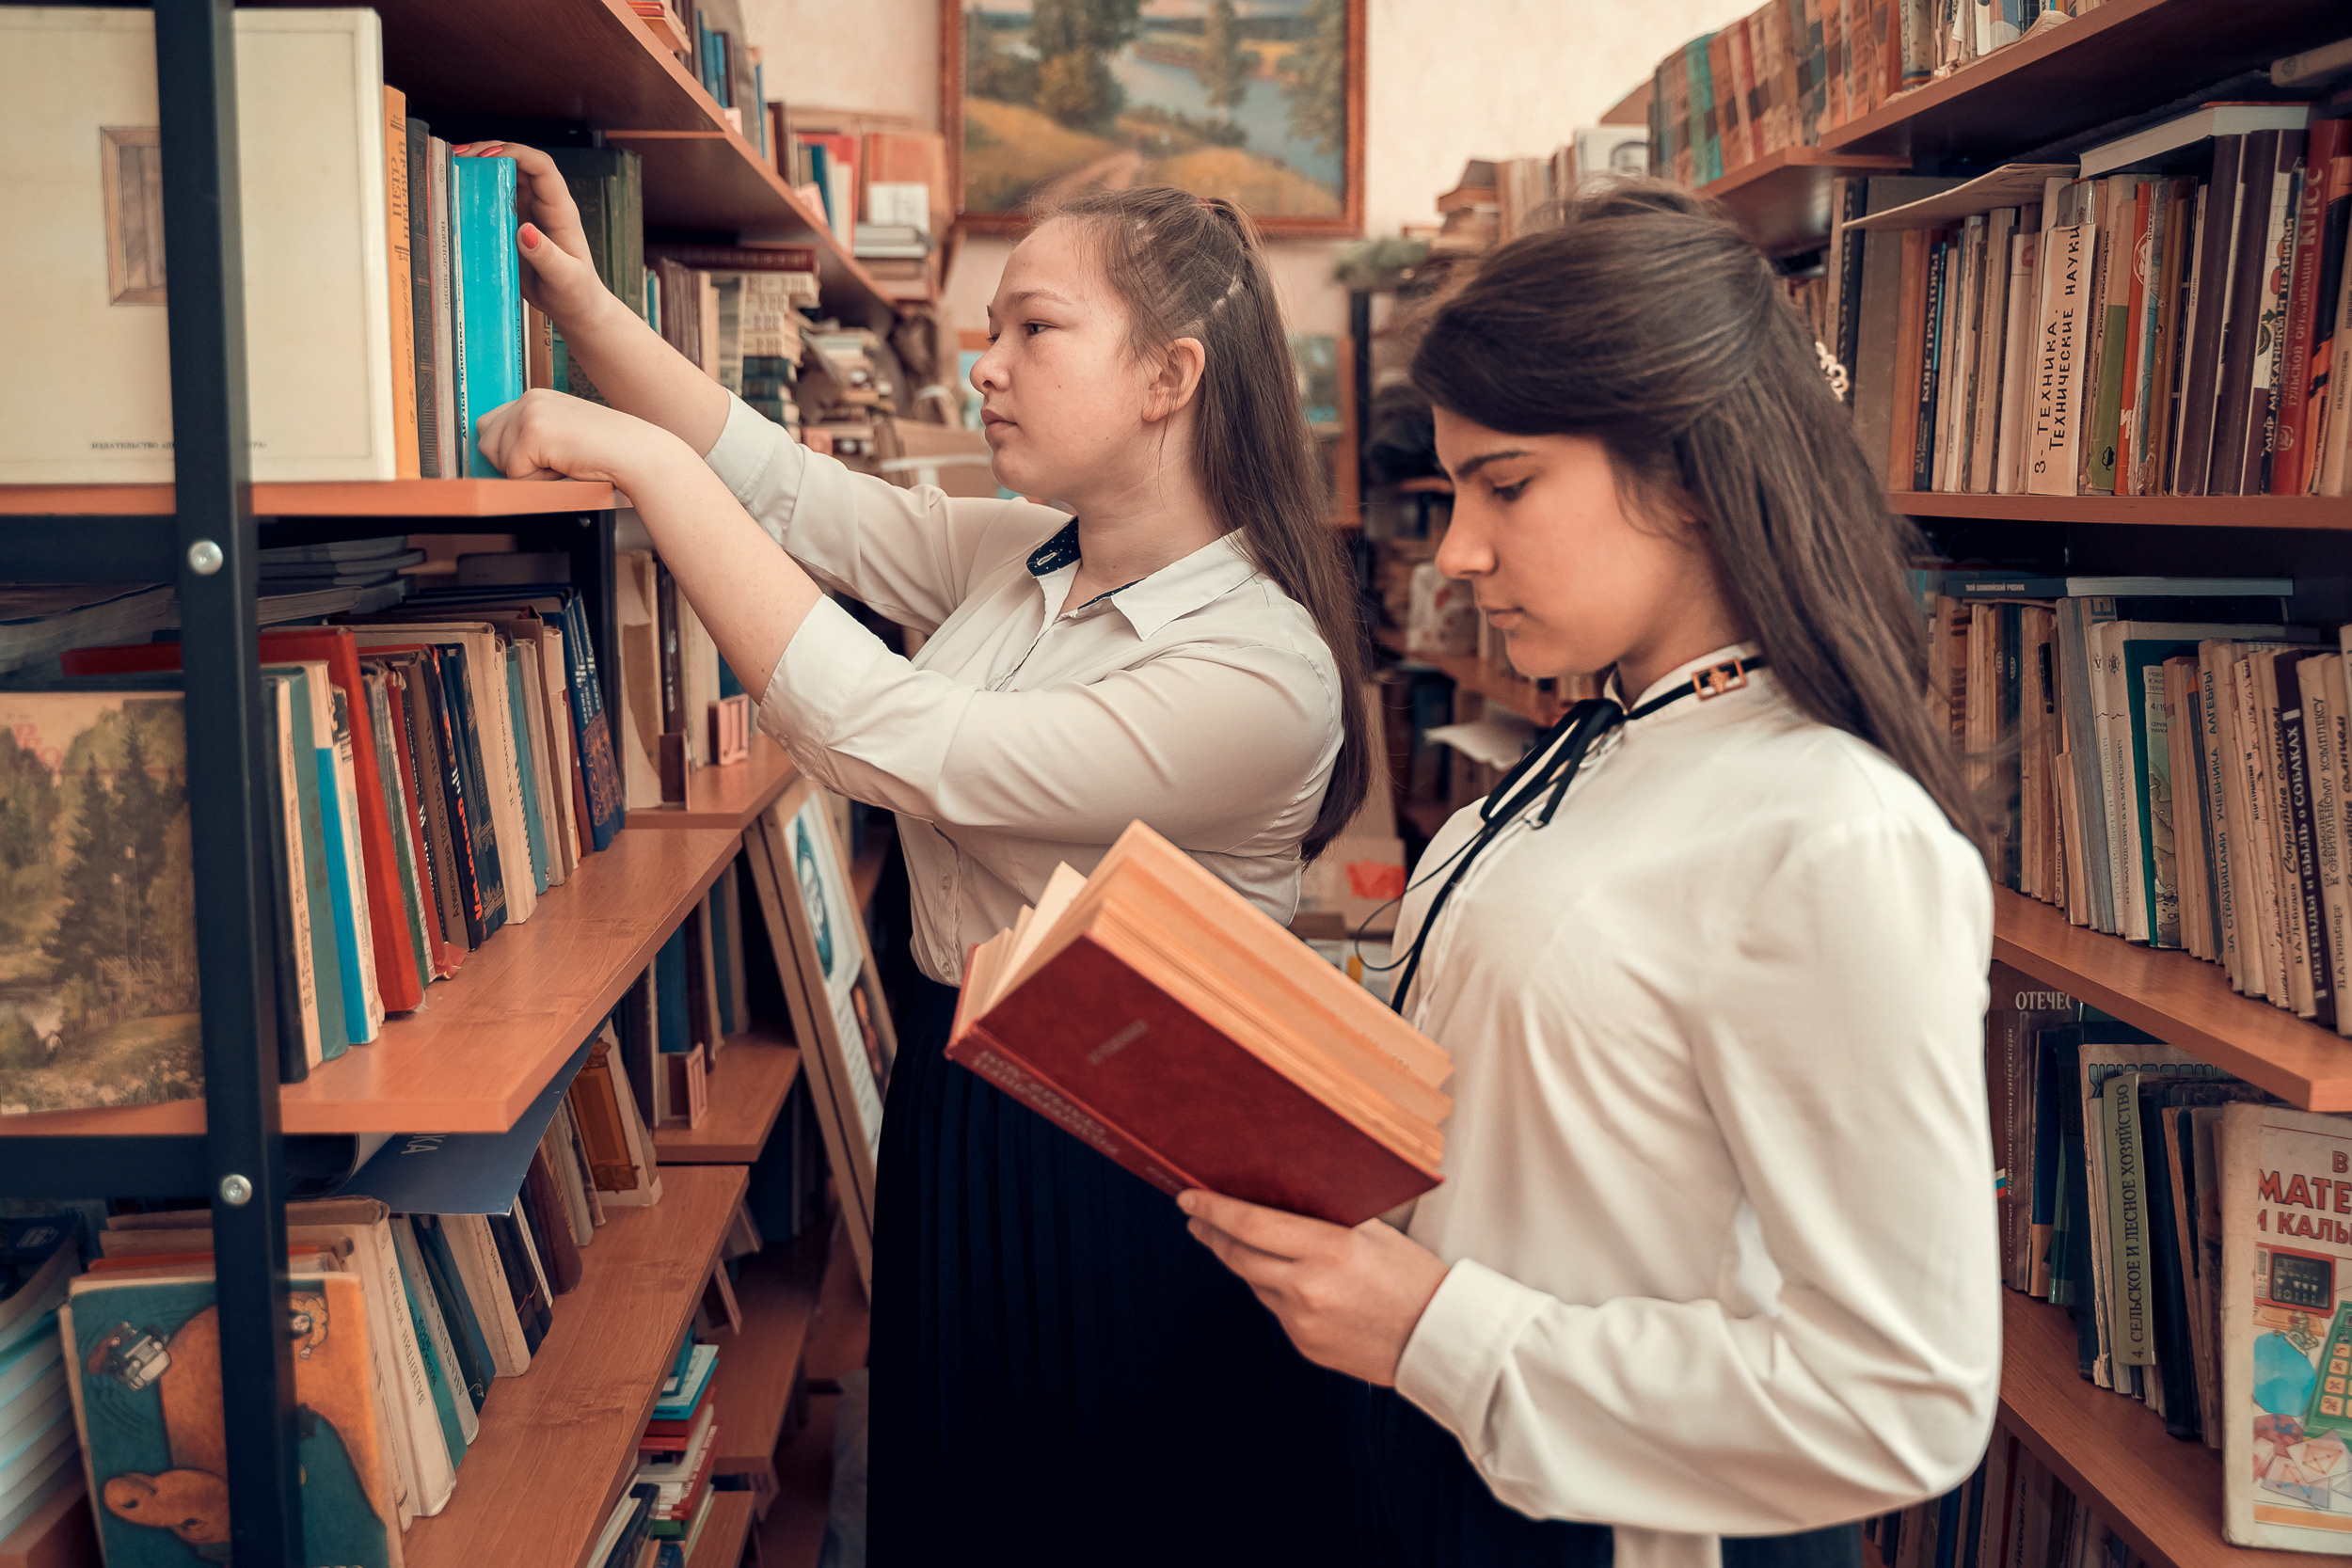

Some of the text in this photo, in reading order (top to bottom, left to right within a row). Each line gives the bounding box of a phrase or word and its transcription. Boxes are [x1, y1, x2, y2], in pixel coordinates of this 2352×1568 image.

[2100, 230, 2110, 300] географии
[2287, 166, 2323, 406] ТУЛЬСКОЙ ОРГАНИЗАЦИИ КПСС
[1921, 252, 1939, 403] КОНСТРУКТОРЫ
[2049, 226, 2080, 451] ТЕХНИЧЕСКИЕ НАУКИ
[2264, 218, 2294, 452] МИР МЕХАНИКИ И ТЕХНИКИ
[89, 441, 159, 450] ИЗДАТЕЛЬСТВО
[2202, 671, 2217, 735] АЛГЕБРЫ
[2272, 706, 2285, 780] солнцем
[2287, 725, 2305, 807] СОБАКАХ
[435, 782, 452, 847] ТОЛСТАЯ
[2210, 747, 2225, 821] УЧЕБНИКА
[2312, 697, 2339, 885] К ОРБИТАЛЬНОМУ КОМПЛЕКСУ
[2279, 786, 2296, 874] Согретые
[2299, 823, 2312, 876] БЫЛЬ
[2316, 799, 2330, 887] ОТ САМОЛЕТА
[444, 845, 461, 919] Александра
[2217, 832, 2233, 929] СТРАНИЦАМИ
[2305, 879, 2313, 889] и
[2227, 933, 2235, 954] ЗА
[2306, 895, 2323, 983] ЛЕГЕНДЫ
[2258, 1168, 2352, 1214] МАТЕ
[2332, 1150, 2348, 1174] В
[2115, 1085, 2144, 1359] 4. СЕЛЬСКОЕ И ЛЕСНОЕ ХОЗЯЙСТВО
[402, 1329, 426, 1406] ВАЛЕНТИН
[437, 1312, 466, 1396] АНАТОЛЬ
